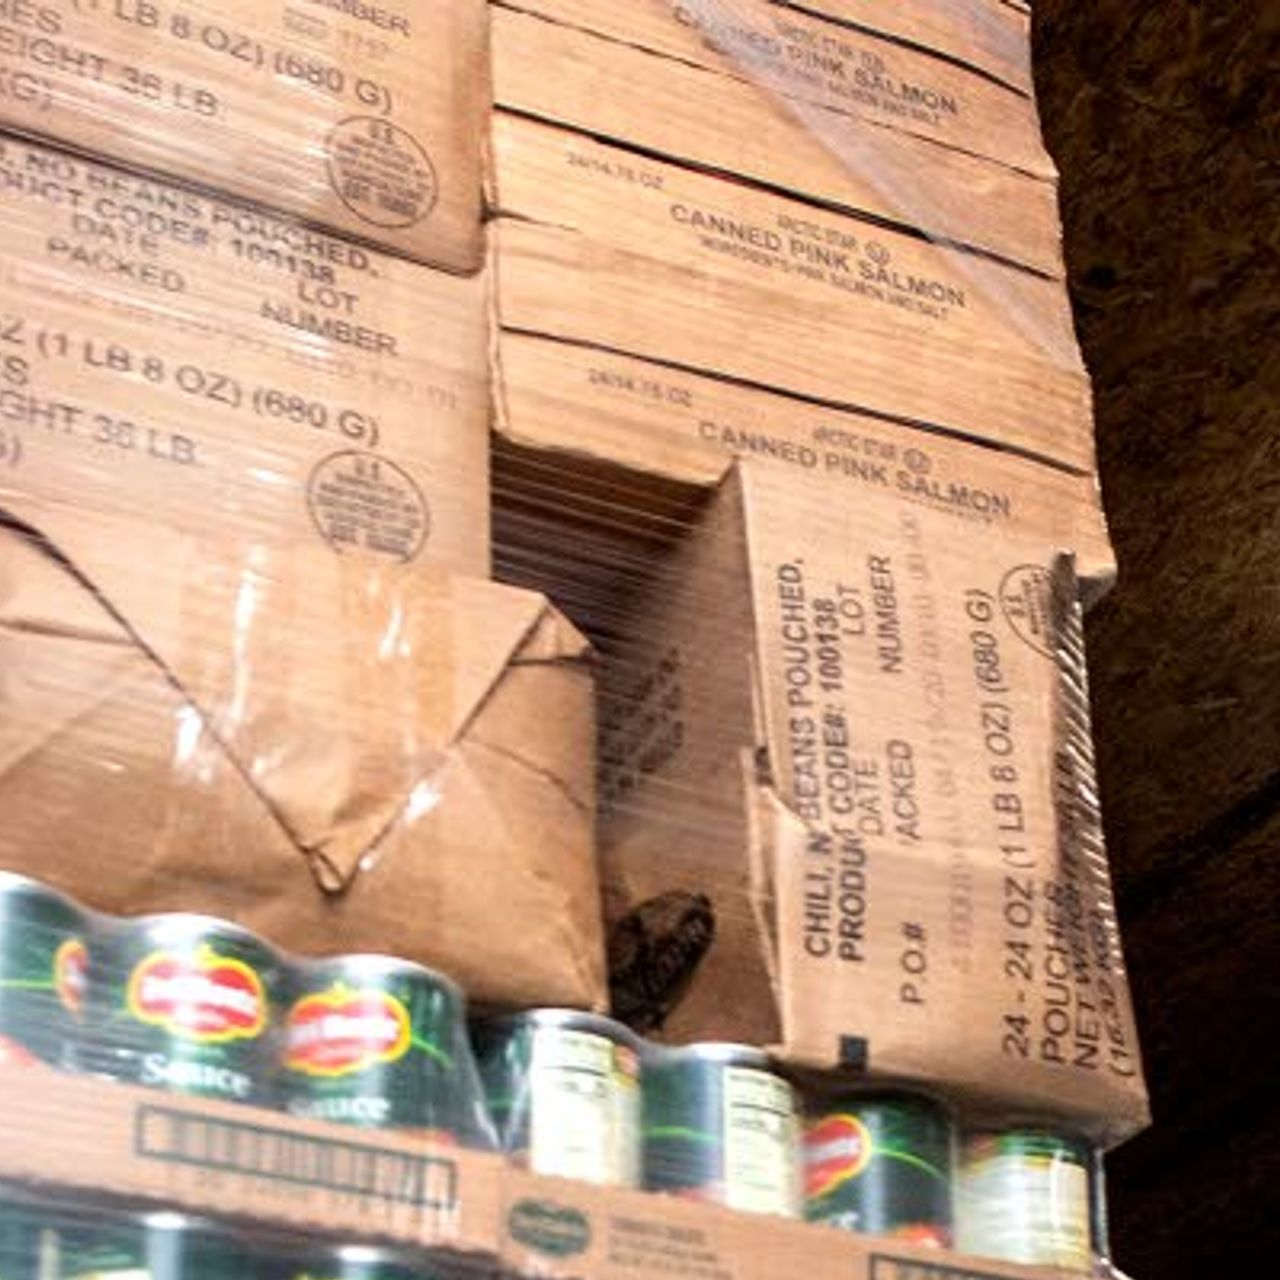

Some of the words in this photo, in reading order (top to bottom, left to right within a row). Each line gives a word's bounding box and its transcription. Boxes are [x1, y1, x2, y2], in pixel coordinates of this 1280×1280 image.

[853, 68, 959, 116] SALMON
[670, 203, 783, 252] CANNED
[788, 238, 852, 275] PINK
[858, 257, 968, 309] SALMON
[297, 282, 361, 314] LOT
[258, 301, 400, 358] NUMBER
[82, 342, 132, 373] LB
[175, 363, 244, 409] OZ)
[339, 409, 380, 449] G)
[146, 427, 197, 466] LB
[697, 420, 818, 469] CANNED
[825, 452, 889, 487] PINK
[895, 473, 1010, 516] SALMON
[836, 582, 866, 637] LOT
[868, 554, 904, 675] NUMBER
[964, 587, 995, 623] G)
[811, 597, 844, 693] 100138
[969, 629, 1010, 695] (680
[980, 702, 1015, 758] OZ)
[789, 716, 822, 821] BEANS
[990, 763, 1019, 784] 8
[853, 757, 885, 838] DATE
[991, 792, 1026, 834] LB
[1000, 843, 1036, 870] (1
[1003, 877, 1035, 931] OZ
[1004, 940, 1034, 982] 24
[1001, 1012, 1032, 1059] 24
[1072, 1000, 1102, 1071] NET
